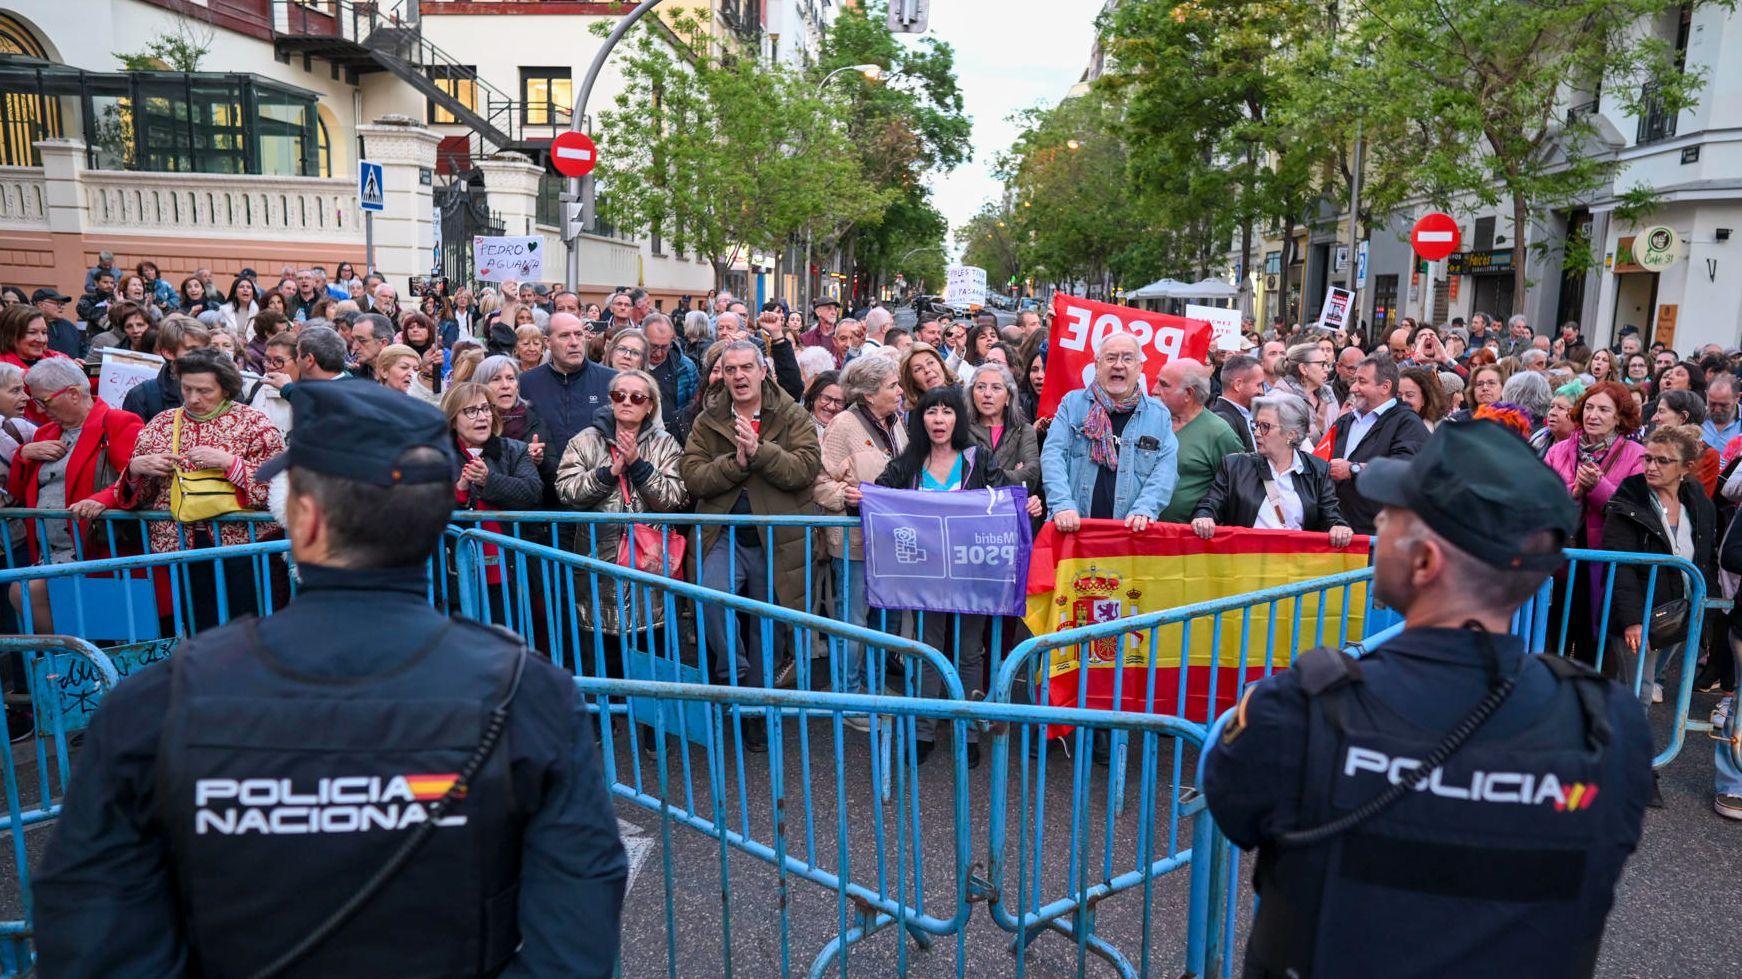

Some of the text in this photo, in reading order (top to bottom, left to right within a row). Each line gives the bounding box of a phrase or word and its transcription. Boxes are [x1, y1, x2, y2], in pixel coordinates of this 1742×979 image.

[480, 244, 524, 256] PEDRO
[487, 258, 540, 270] AGUANTA
[196, 775, 416, 806] POLICIA
[1344, 746, 1567, 804] POLICIA
[196, 803, 467, 835] NACIONAL
